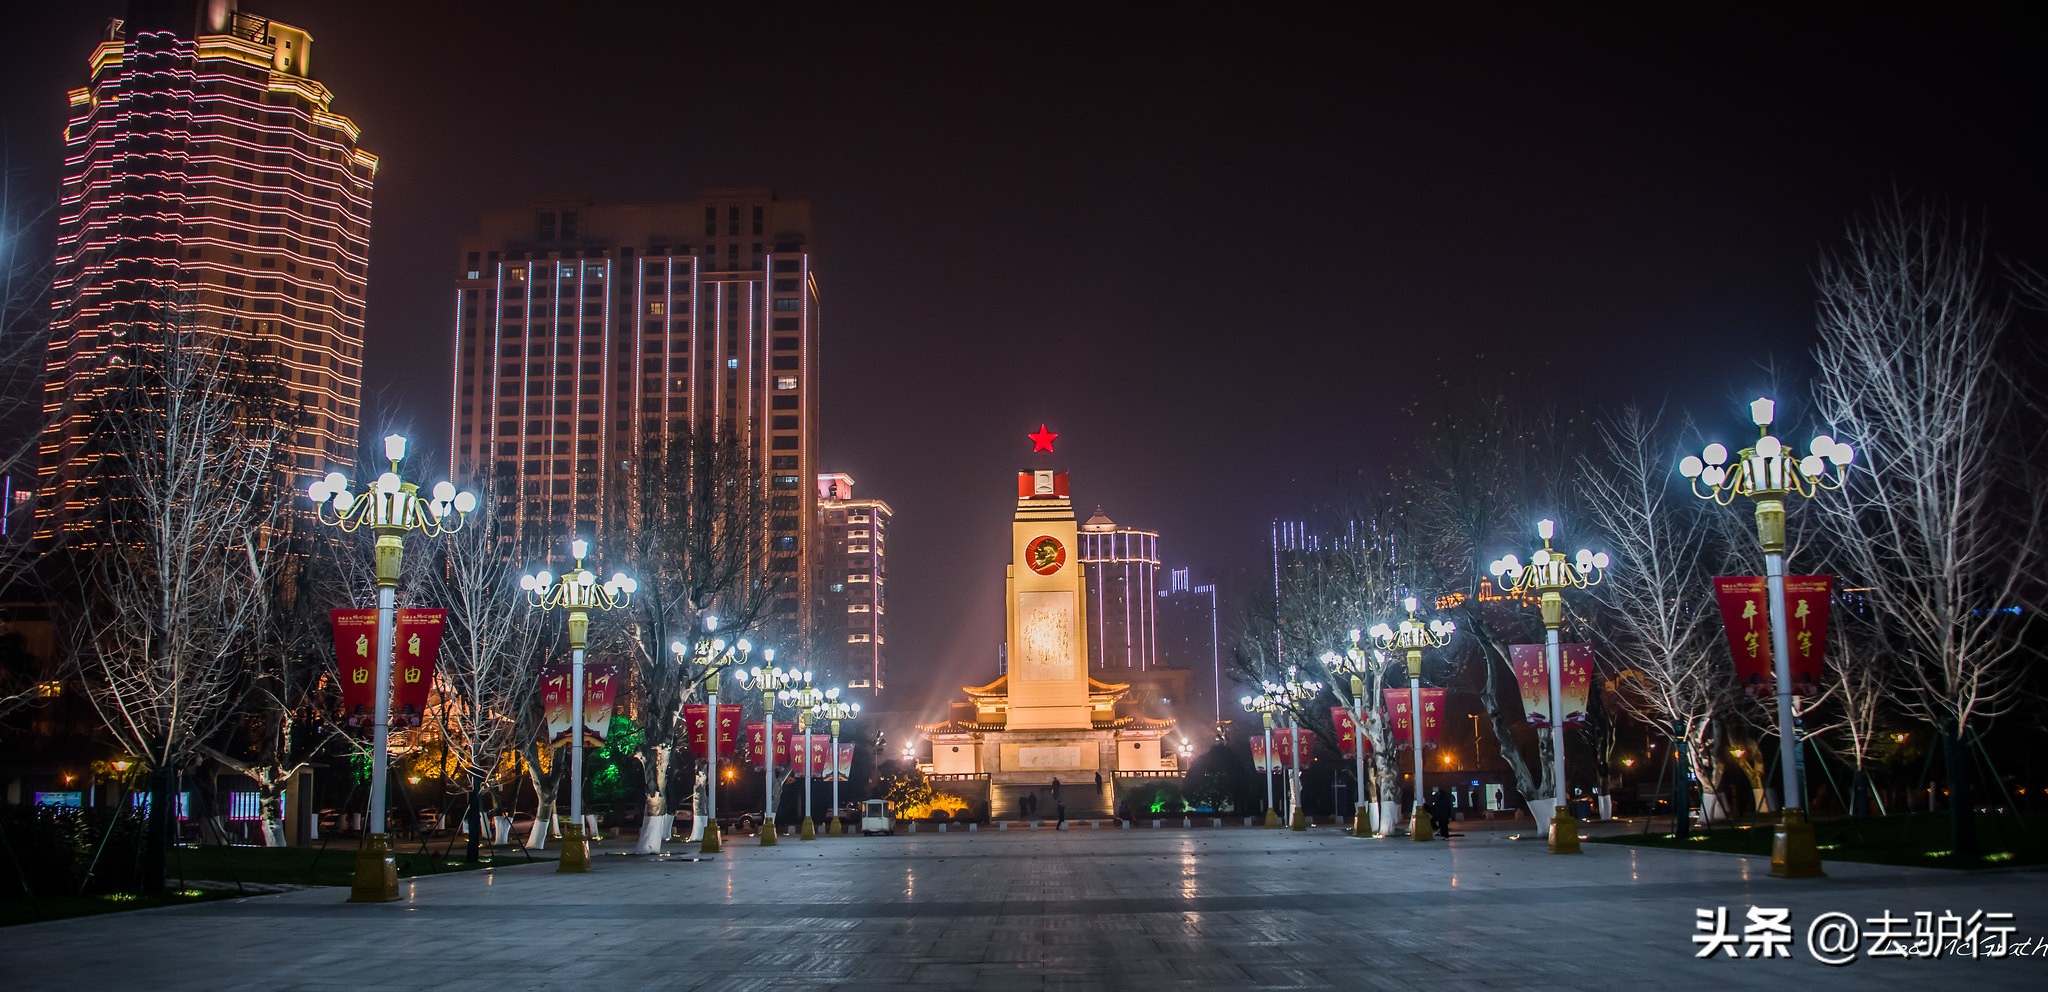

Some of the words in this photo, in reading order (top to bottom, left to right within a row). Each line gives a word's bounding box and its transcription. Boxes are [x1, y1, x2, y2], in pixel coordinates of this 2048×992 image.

[1742, 599, 1760, 658] 平等
[1794, 599, 1813, 658] 平等
[352, 633, 369, 685] 自由
[404, 632, 421, 684] 自由
[694, 719, 706, 743] 公正
[720, 718, 732, 742] 公正
